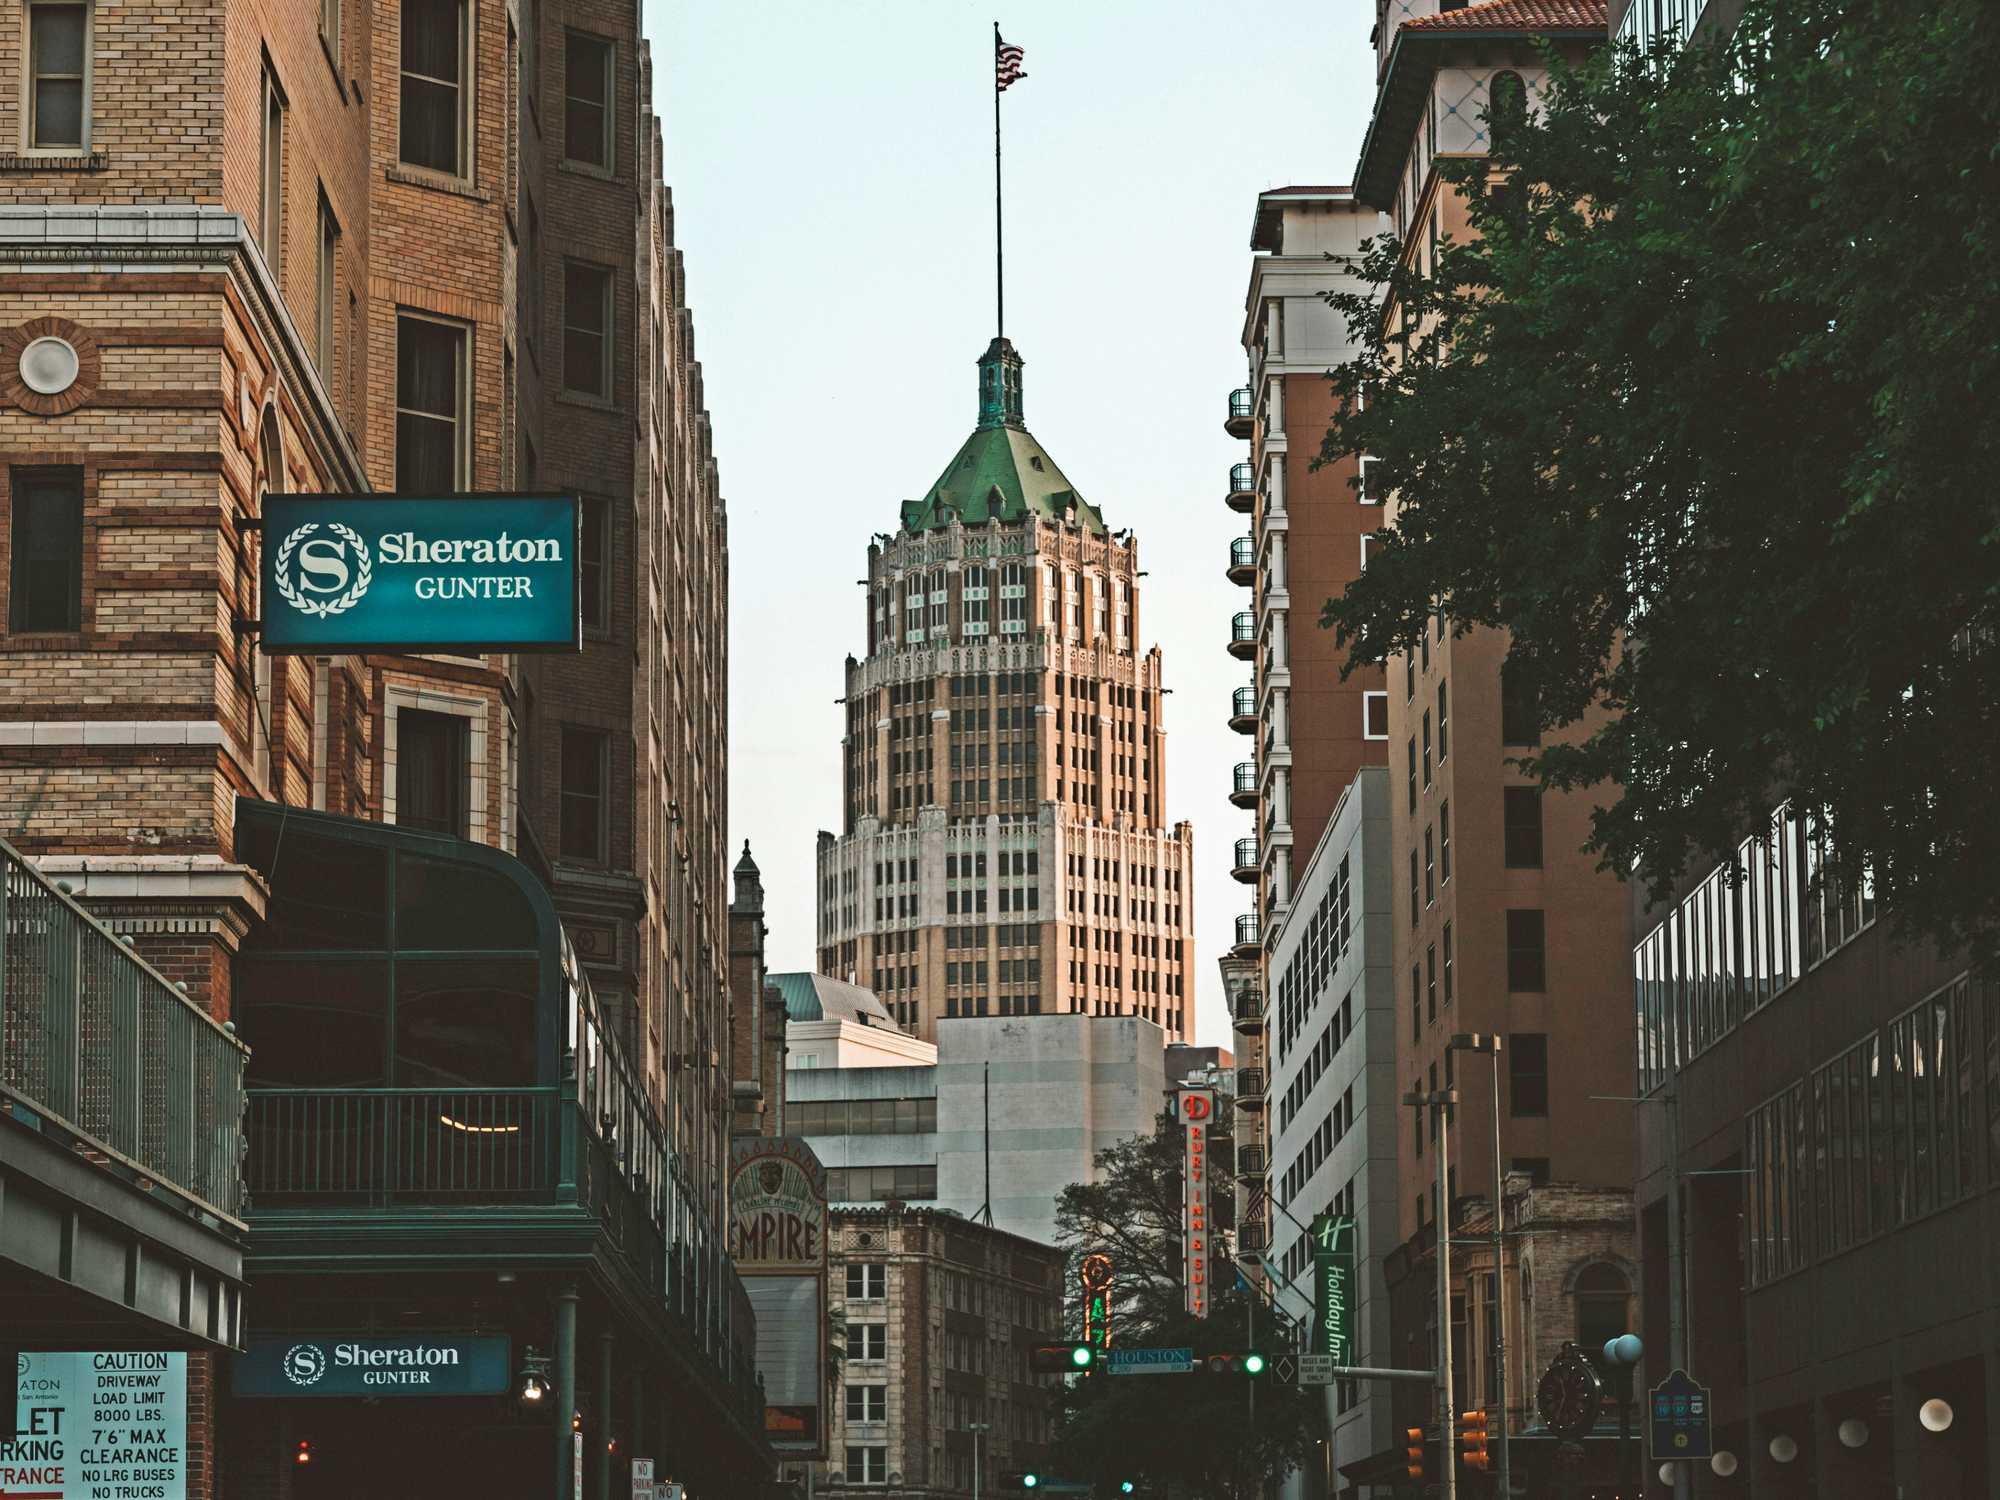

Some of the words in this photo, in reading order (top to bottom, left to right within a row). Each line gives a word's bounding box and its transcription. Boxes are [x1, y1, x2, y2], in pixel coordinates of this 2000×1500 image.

[379, 531, 562, 564] Sheraton
[415, 577, 533, 599] GUNTER
[1183, 1095, 1210, 1182] DRURY
[1192, 1190, 1203, 1230] INN
[1325, 1265, 1345, 1332] Holiday
[335, 1344, 459, 1366] Sheraton
[1329, 1335, 1346, 1363] Inn
[93, 1353, 168, 1369] CAUTION
[1115, 1351, 1185, 1364] HOUSTON
[97, 1376, 161, 1388] DRIVEWAY
[363, 1371, 431, 1385] GUNTER
[93, 1392, 127, 1404] LOAD
[134, 1392, 166, 1404] LIMIT
[94, 1410, 131, 1422] 8000
[136, 1409, 165, 1421] LBS.
[131, 1429, 166, 1444] MAX
[80, 1448, 179, 1464] CLEARANCE
[82, 1471, 100, 1482] NO
[104, 1470, 129, 1481] LRG
[133, 1469, 175, 1481] BUSES
[638, 1463, 648, 1476] NO
[633, 1478, 653, 1489] PARKING
[92, 1487, 110, 1499] NO
[116, 1486, 165, 1498] TRUCKS
[658, 1487, 673, 1499] NO
